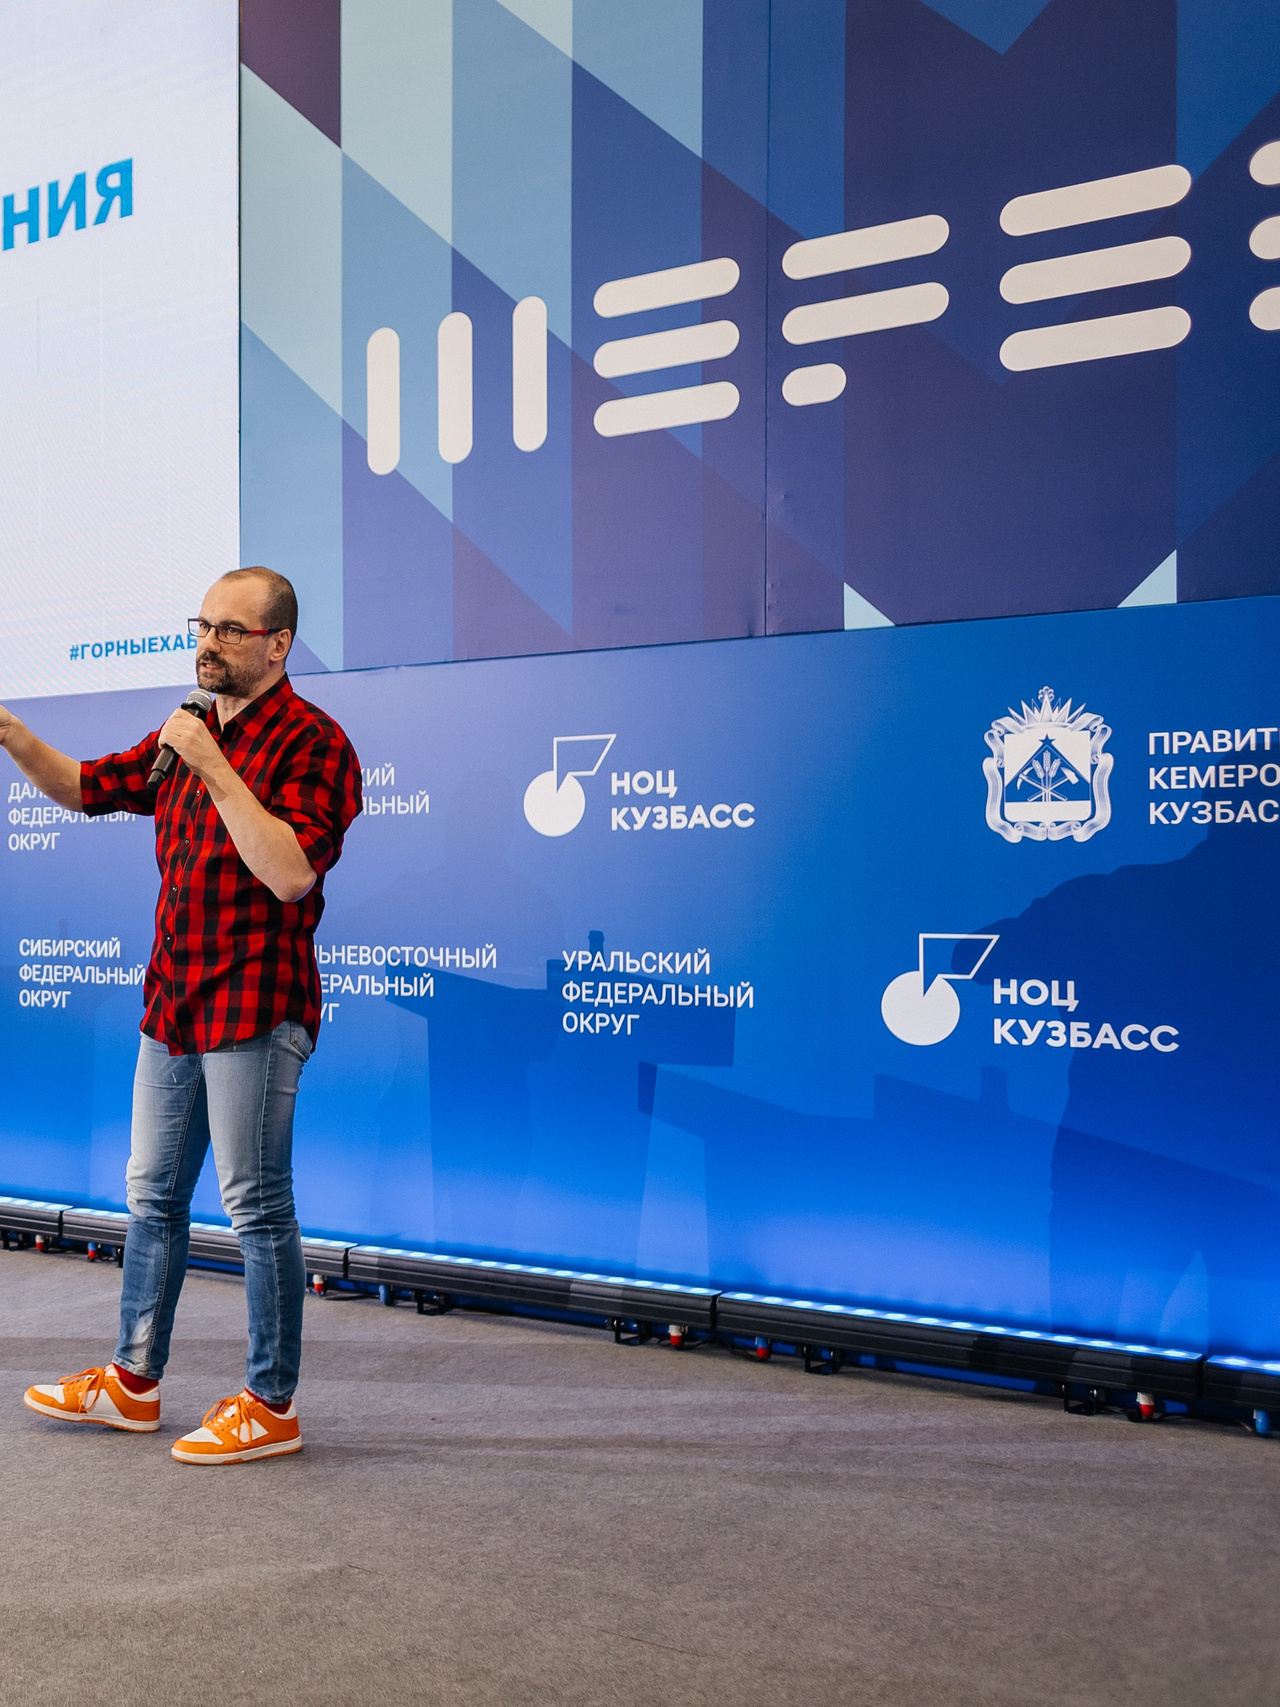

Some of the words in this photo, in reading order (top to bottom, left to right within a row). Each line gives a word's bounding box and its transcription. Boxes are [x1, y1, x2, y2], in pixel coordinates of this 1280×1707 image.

[1148, 727, 1280, 755] ПРАВИТ
[611, 770, 678, 798] НОЦ
[611, 802, 756, 831] КУЗБАСС
[8, 832, 61, 851] ОКРУГ
[19, 937, 121, 959] СИБИРСКИЙ
[314, 943, 497, 969] ЬНЕВОСТОЧНЫЙ
[562, 947, 712, 975] УРАЛЬСКИЙ
[19, 964, 147, 986] ФЕДЕРАЛЬНЫЙ
[320, 972, 435, 998] ЕРАЛЬНЫЙ
[19, 989, 72, 1009] ОКРУГ
[562, 979, 755, 1009] ФЕДЕРАЛЬНЫЙ
[992, 978, 1079, 1012] НОЦ
[562, 1012, 640, 1036] ОКРУГ
[992, 1018, 1180, 1053] КУЗБАСС
